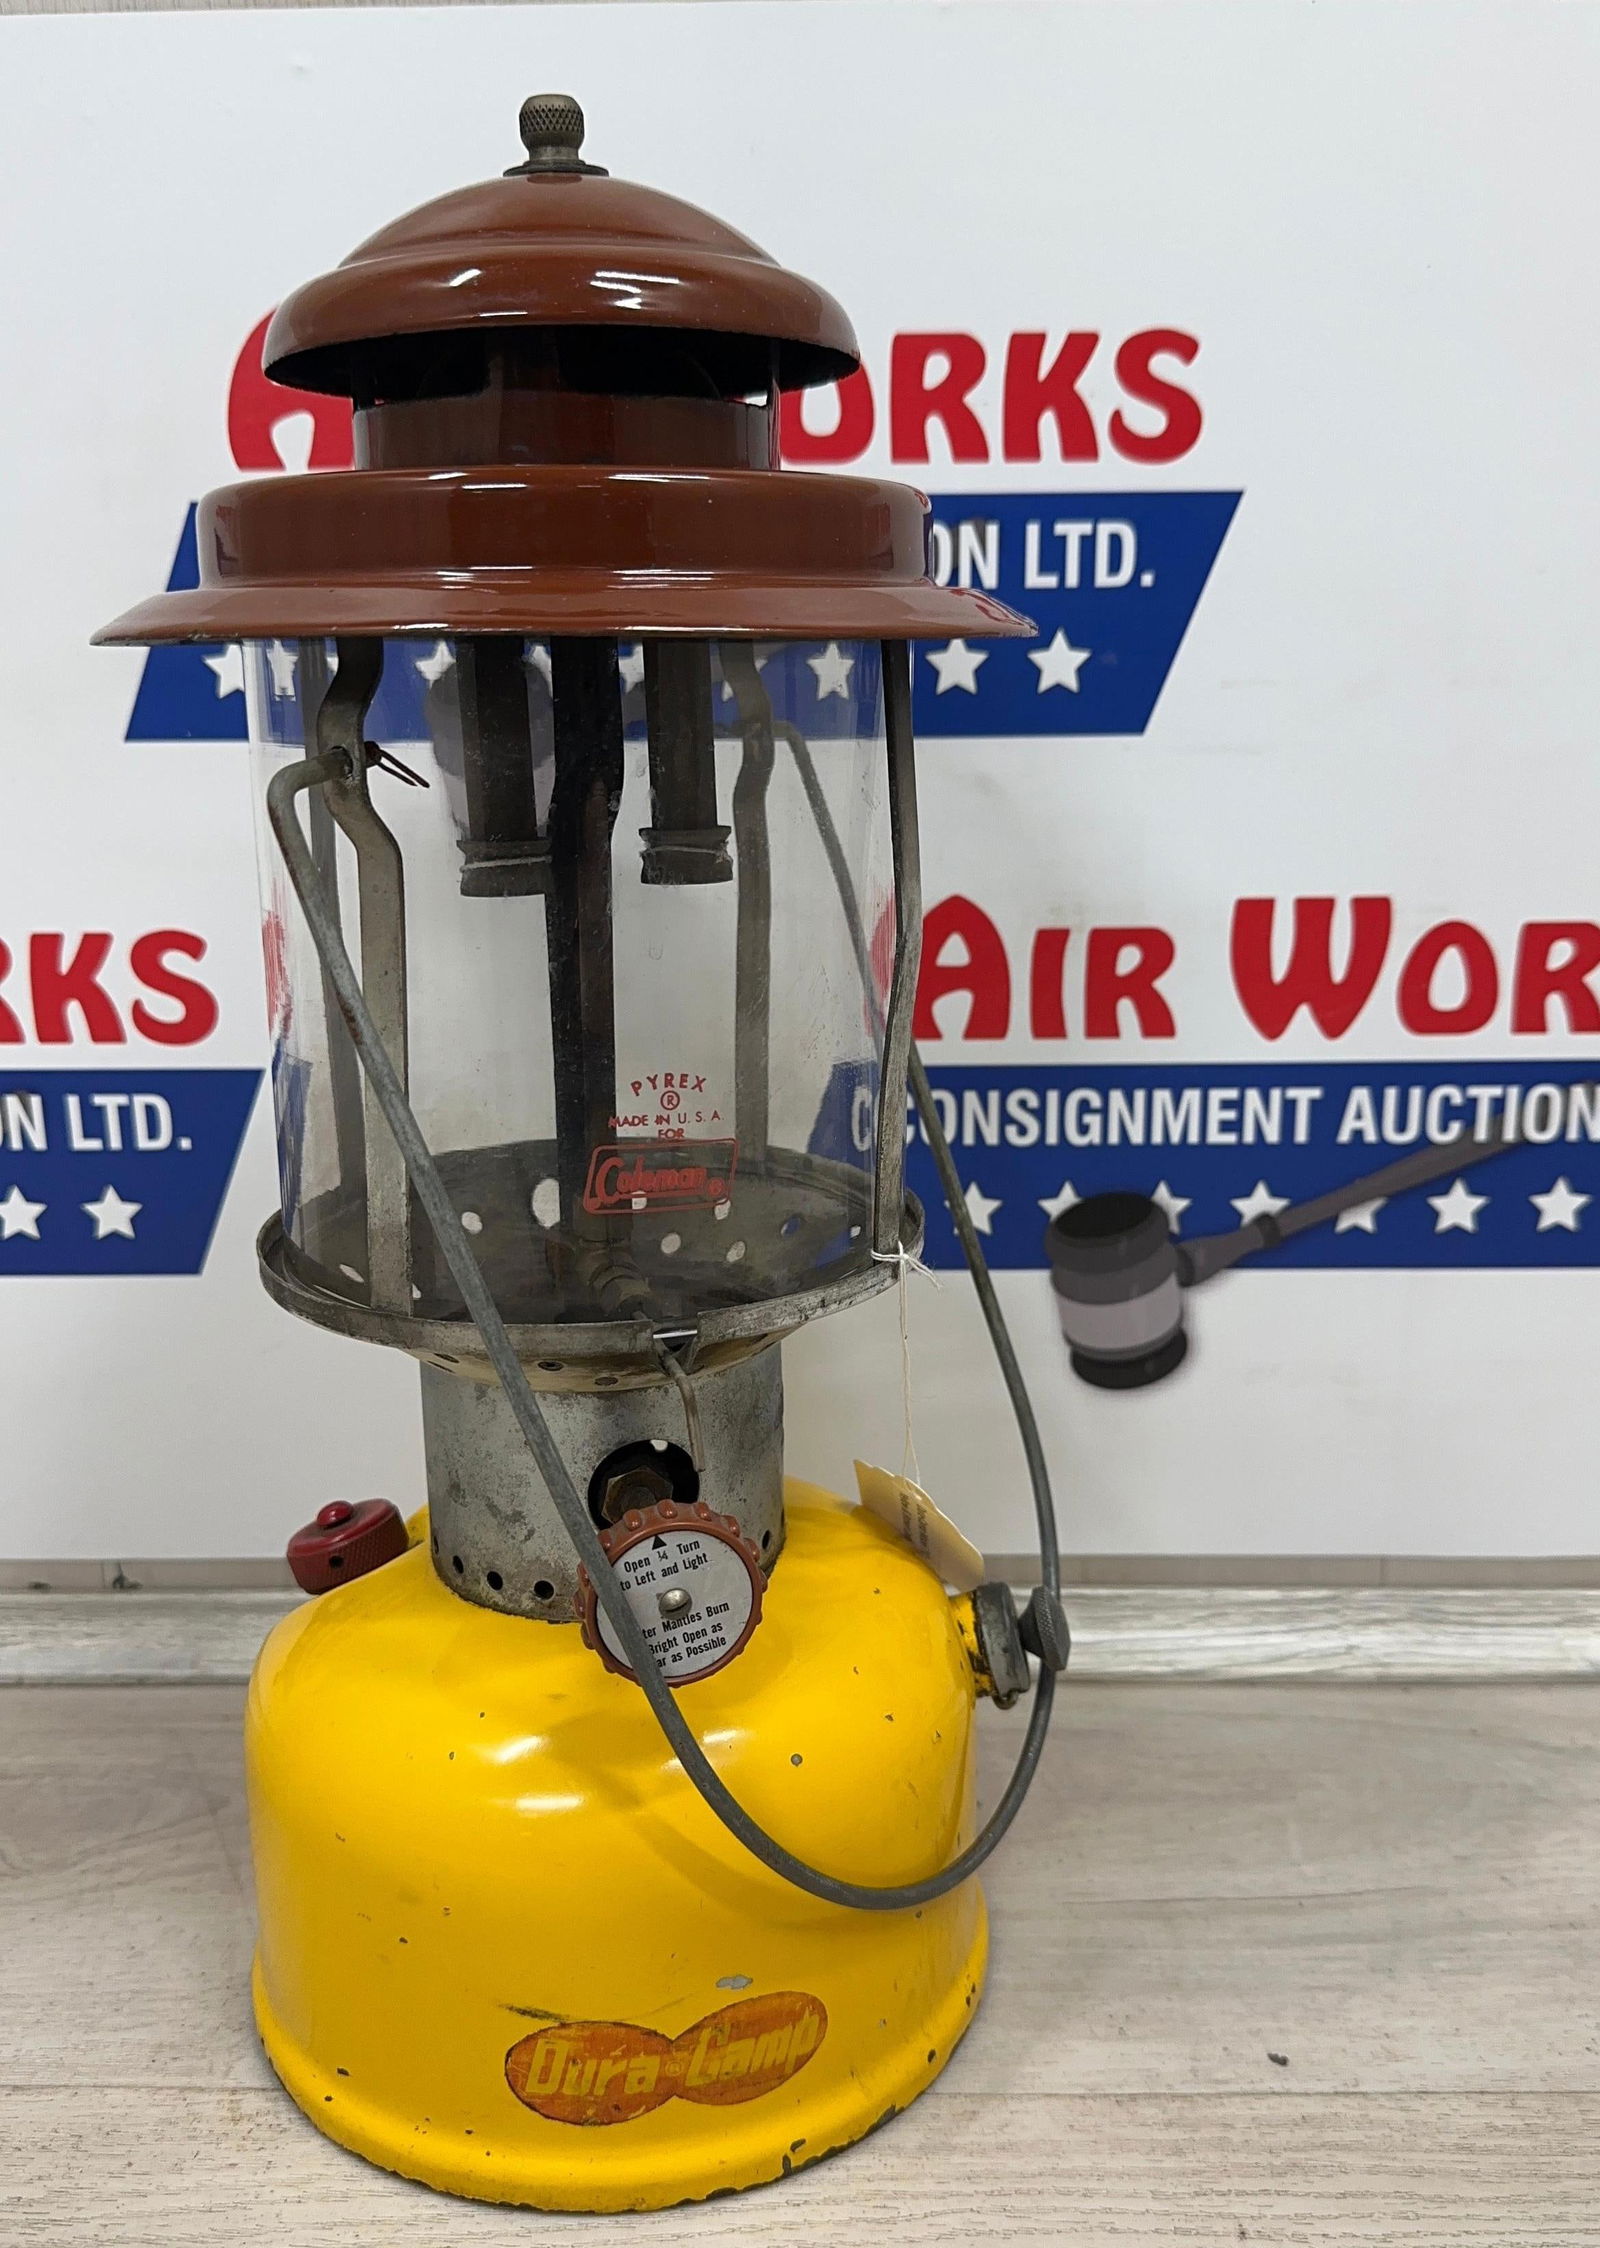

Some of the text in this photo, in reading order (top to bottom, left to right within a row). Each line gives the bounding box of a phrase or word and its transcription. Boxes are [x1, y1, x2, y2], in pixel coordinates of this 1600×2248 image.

[780, 326, 1204, 466] ORKS
[1023, 520, 1156, 590] LTD.
[911, 893, 1177, 1042] AIR
[630, 1072, 706, 1096] PYREX
[65, 1092, 194, 1153] LTD.
[608, 1114, 648, 1127] MADE
[654, 1113, 670, 1125] IN
[657, 1127, 685, 1139] FOR
[1336, 1082, 1600, 1148] AUCTION
[594, 1155, 708, 1205] Coleman
[619, 1552, 708, 1591] to Left and Light
[623, 1556, 650, 1574] Open
[676, 1539, 700, 1554] Turn
[642, 1602, 729, 1639] ter Mantles Burn
[682, 1627, 707, 1644] Open
[710, 1621, 723, 1633] as
[656, 1635, 726, 1667] ar as Possible
